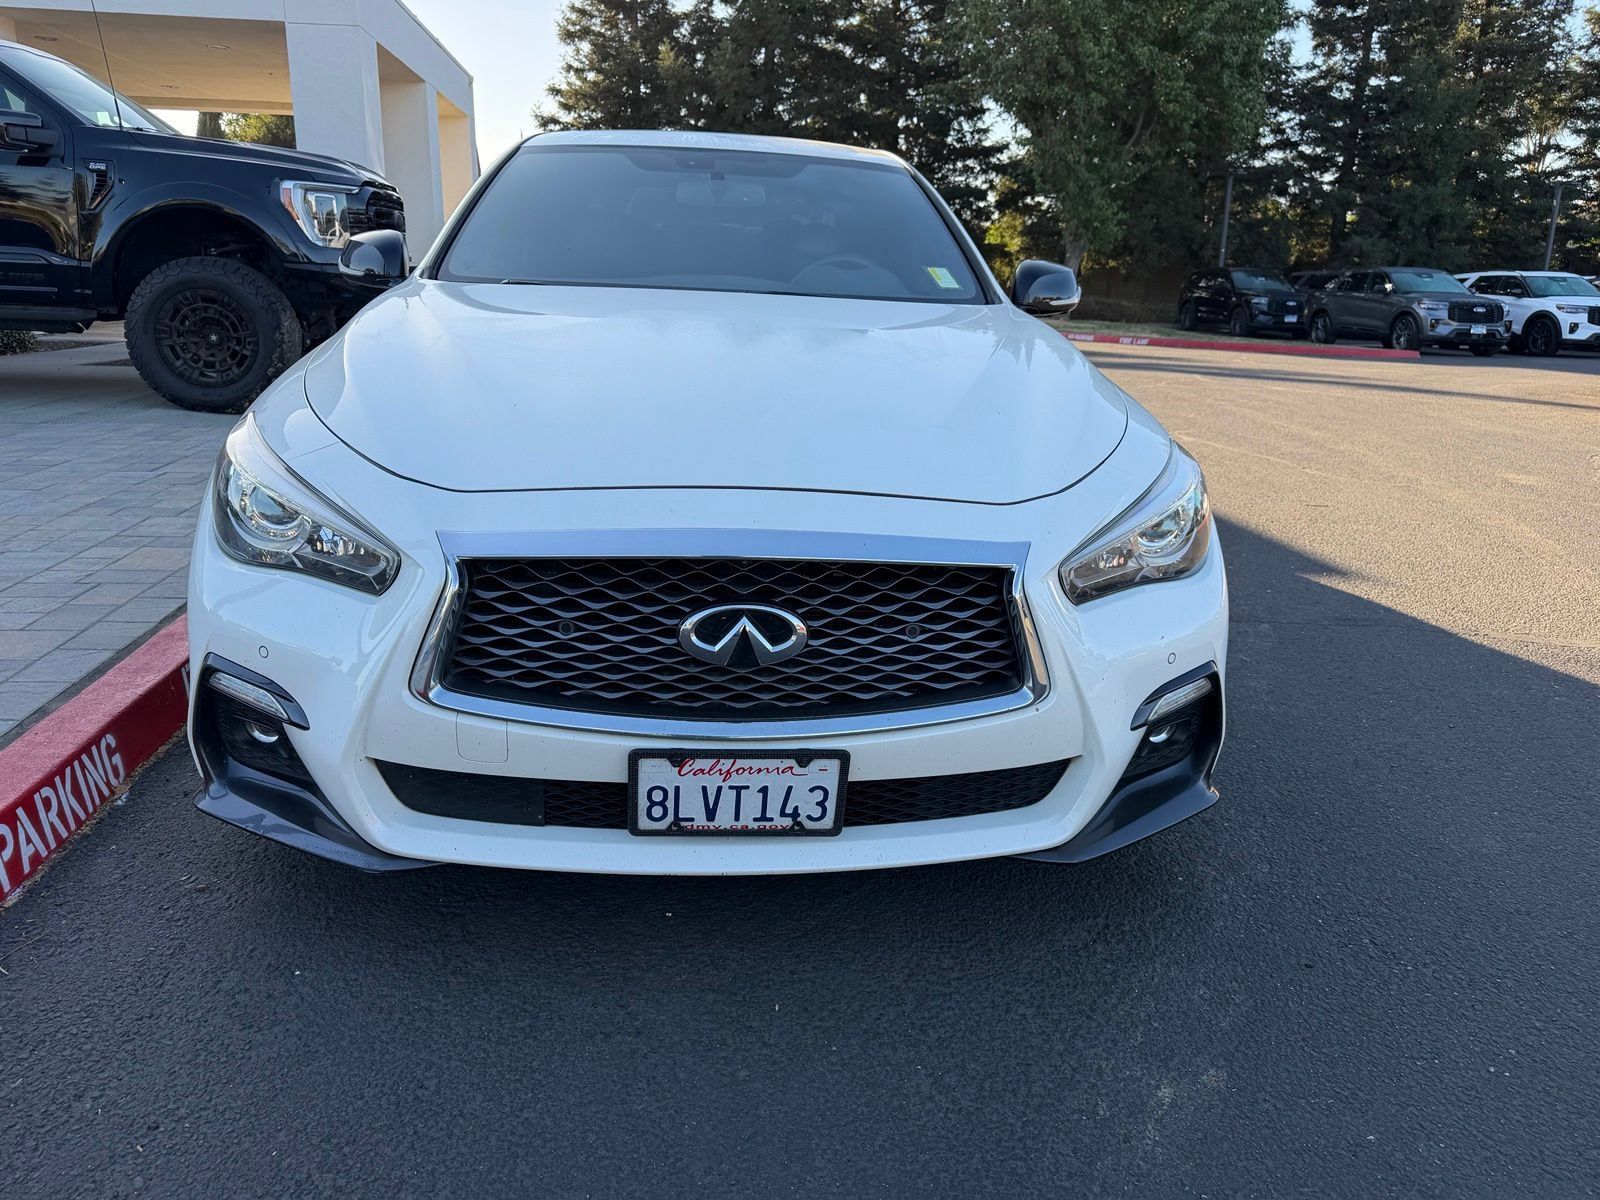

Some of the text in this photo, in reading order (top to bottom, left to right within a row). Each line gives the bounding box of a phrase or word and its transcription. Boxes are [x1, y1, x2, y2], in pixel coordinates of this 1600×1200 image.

[677, 758, 808, 783] California
[0, 732, 126, 894] PARKING
[645, 785, 830, 823] 8LVT143
[684, 823, 791, 831] dmv.ca.gov
